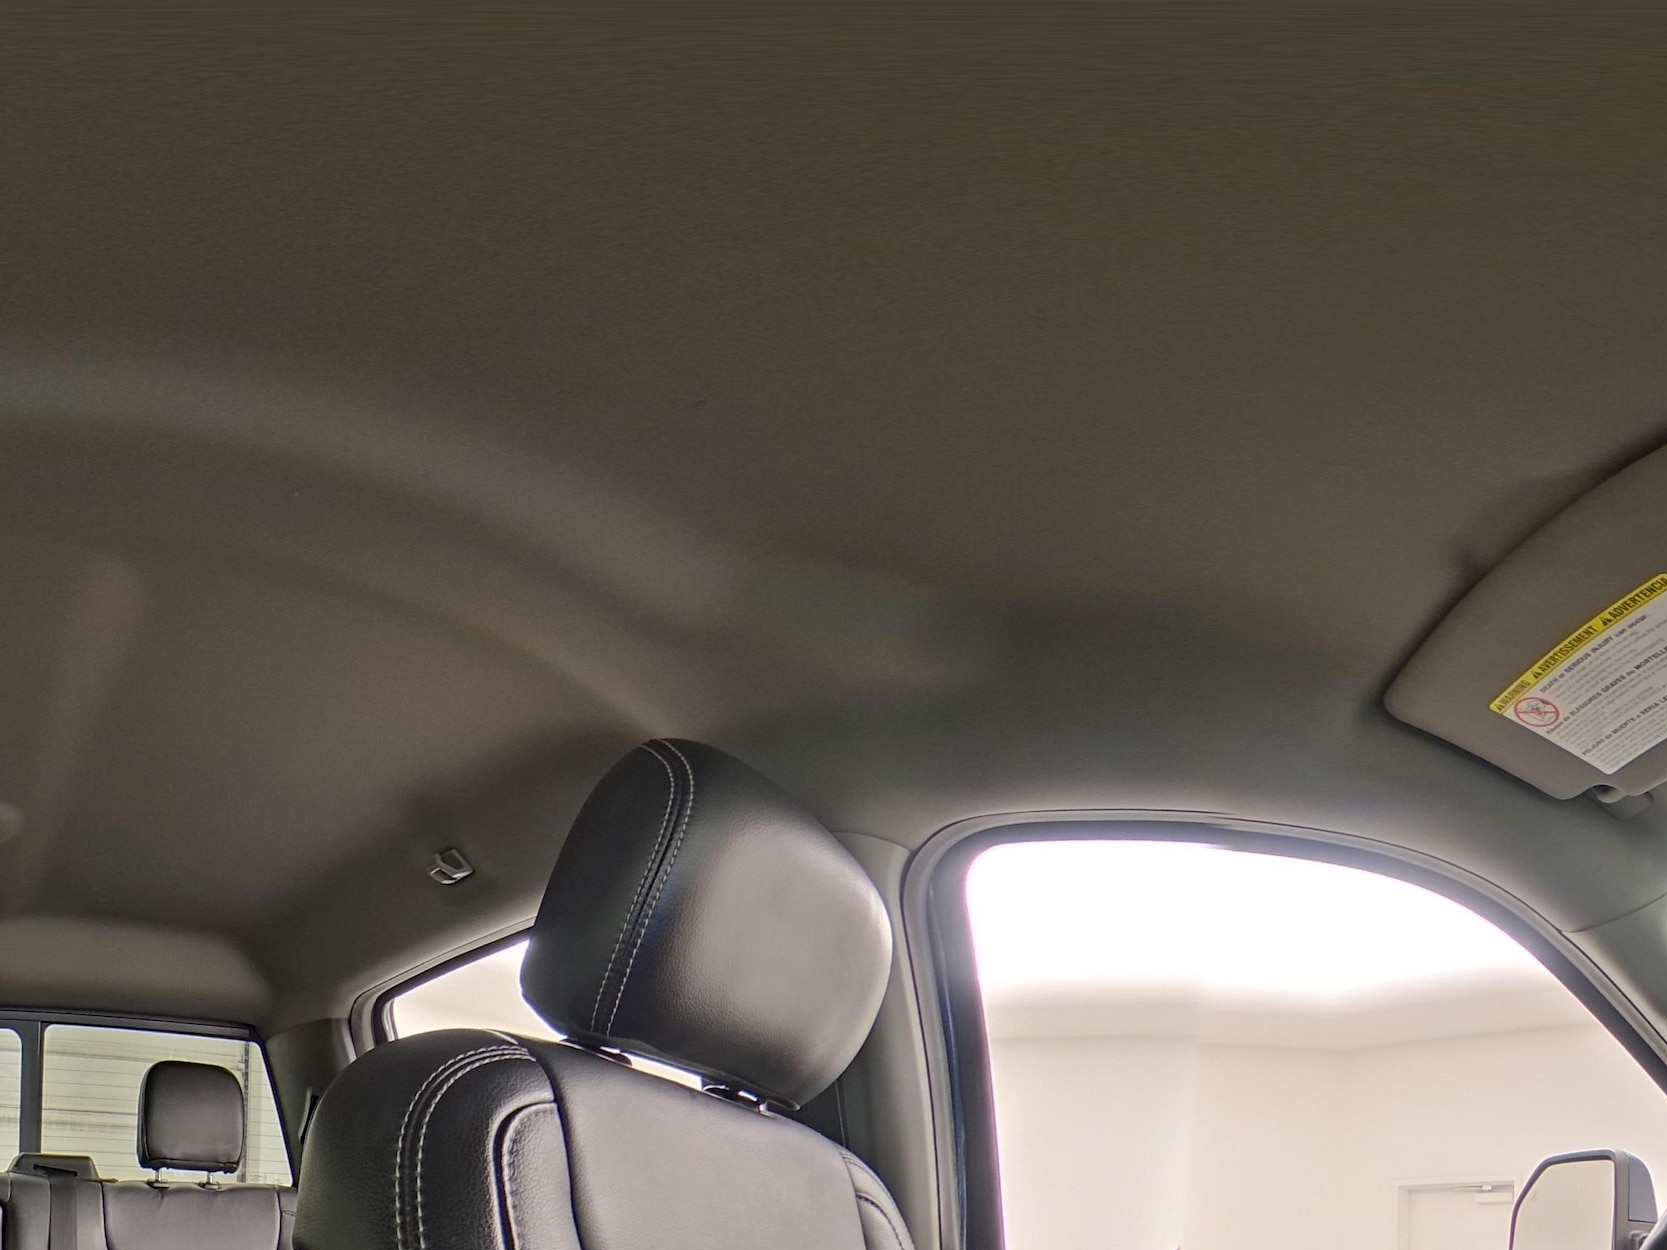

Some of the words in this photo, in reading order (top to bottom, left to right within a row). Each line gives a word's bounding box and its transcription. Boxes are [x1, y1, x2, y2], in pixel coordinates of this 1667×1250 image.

[1498, 678, 1532, 706] WARNING
[1537, 624, 1599, 673] AVERTISSEMENT
[1563, 651, 1592, 673] SERIOUS
[1600, 674, 1627, 693] GRAVES
